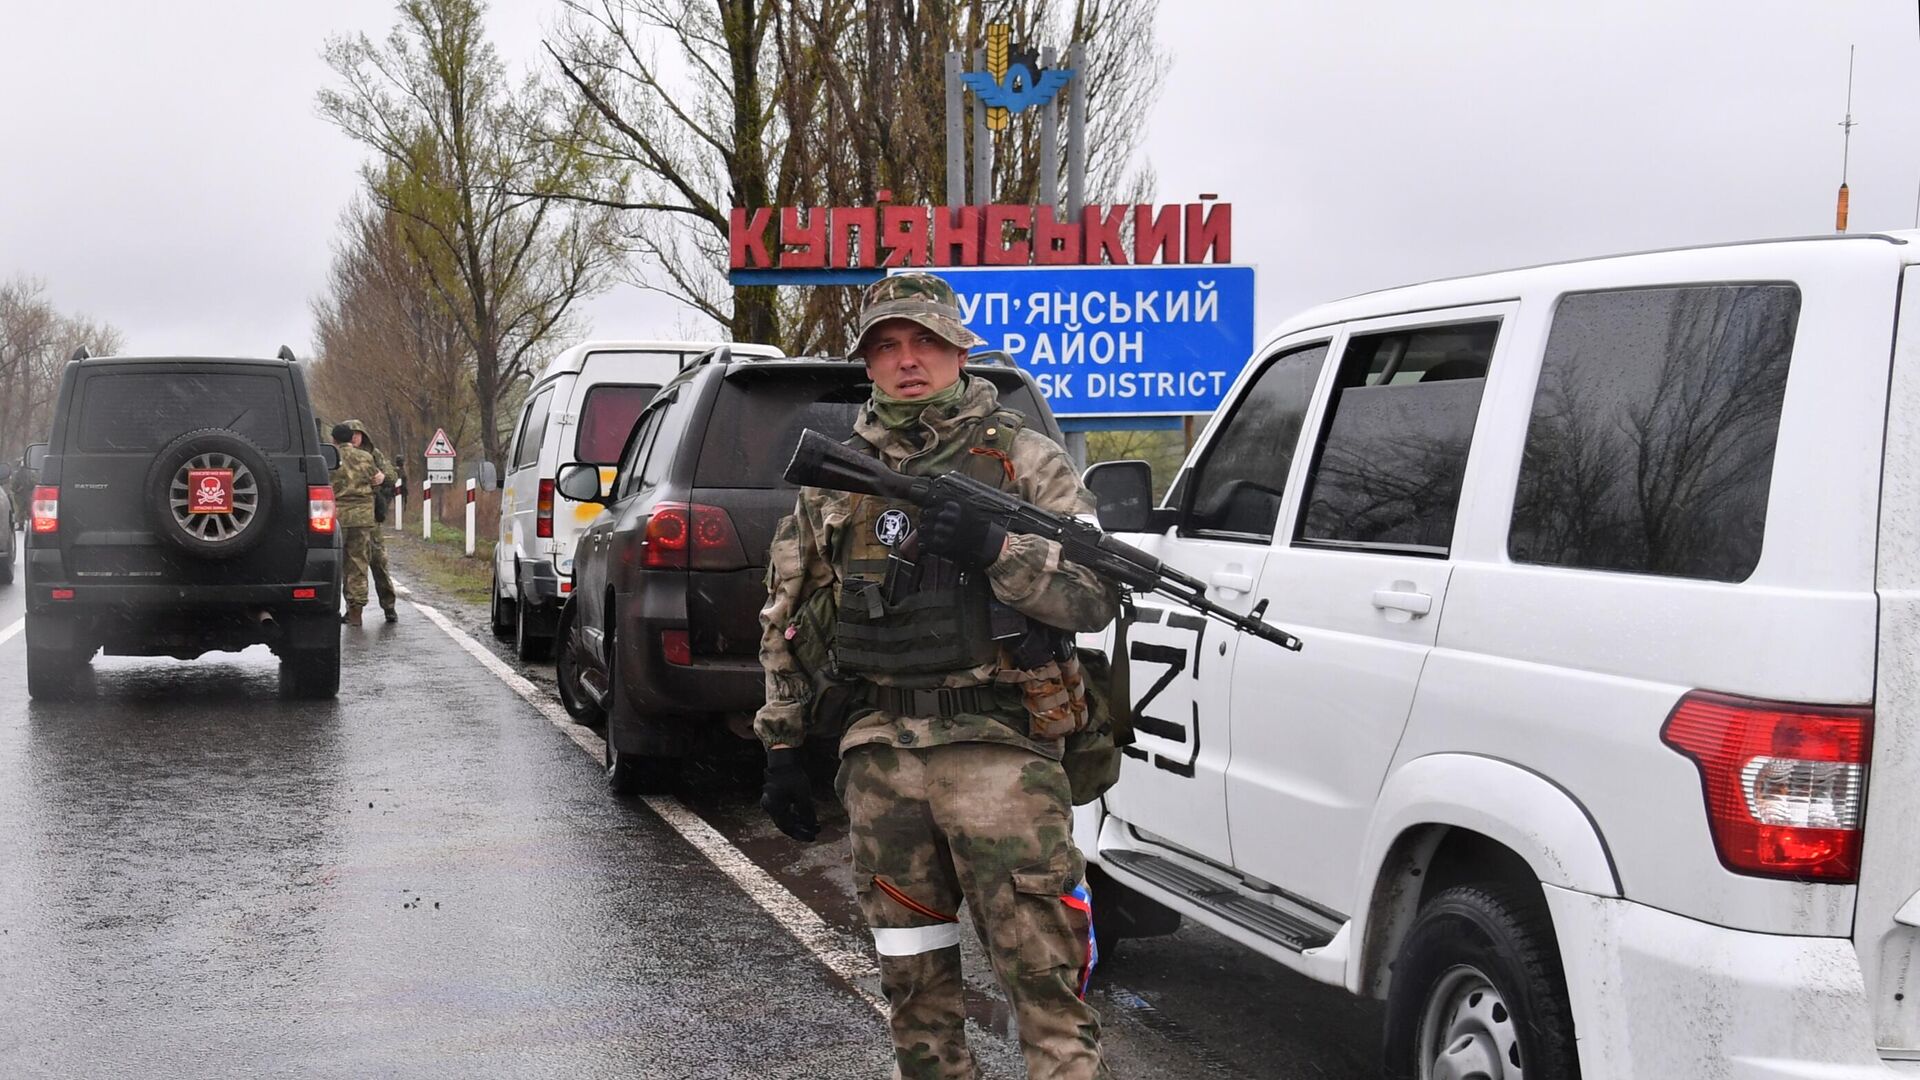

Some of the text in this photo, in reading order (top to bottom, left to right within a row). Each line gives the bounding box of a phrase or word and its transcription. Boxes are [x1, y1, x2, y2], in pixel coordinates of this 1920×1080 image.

[730, 190, 1232, 269] КУП'ЯНСЬКИЙ
[957, 281, 1218, 325] УП'ЯНСЬКИЙ
[1003, 322, 1143, 365] РАЙОН
[1088, 371, 1226, 398] DISTRICT
[1130, 641, 1187, 743] Z
